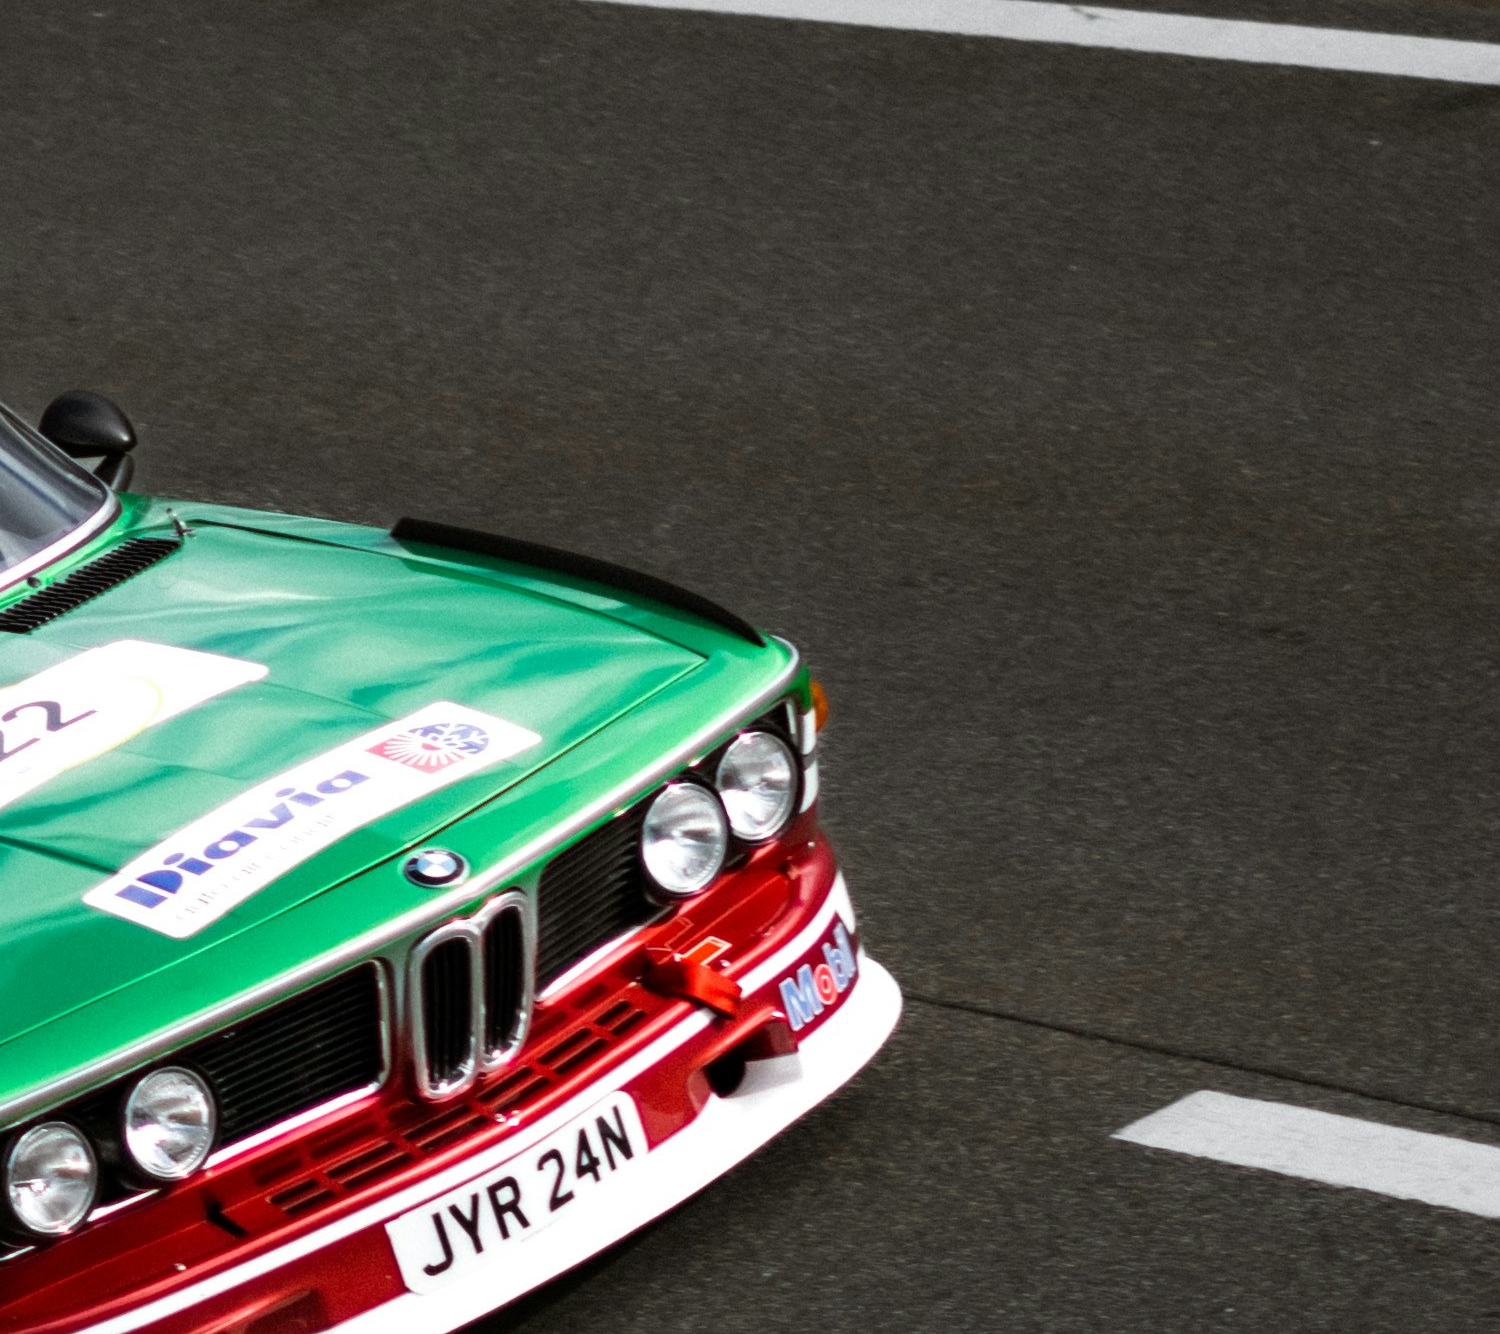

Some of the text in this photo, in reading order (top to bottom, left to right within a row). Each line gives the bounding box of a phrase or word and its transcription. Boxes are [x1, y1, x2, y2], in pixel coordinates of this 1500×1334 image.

[114, 769, 370, 909] Diavia
[778, 922, 857, 1032] Mobil
[422, 1104, 634, 1277] JYR 24N
